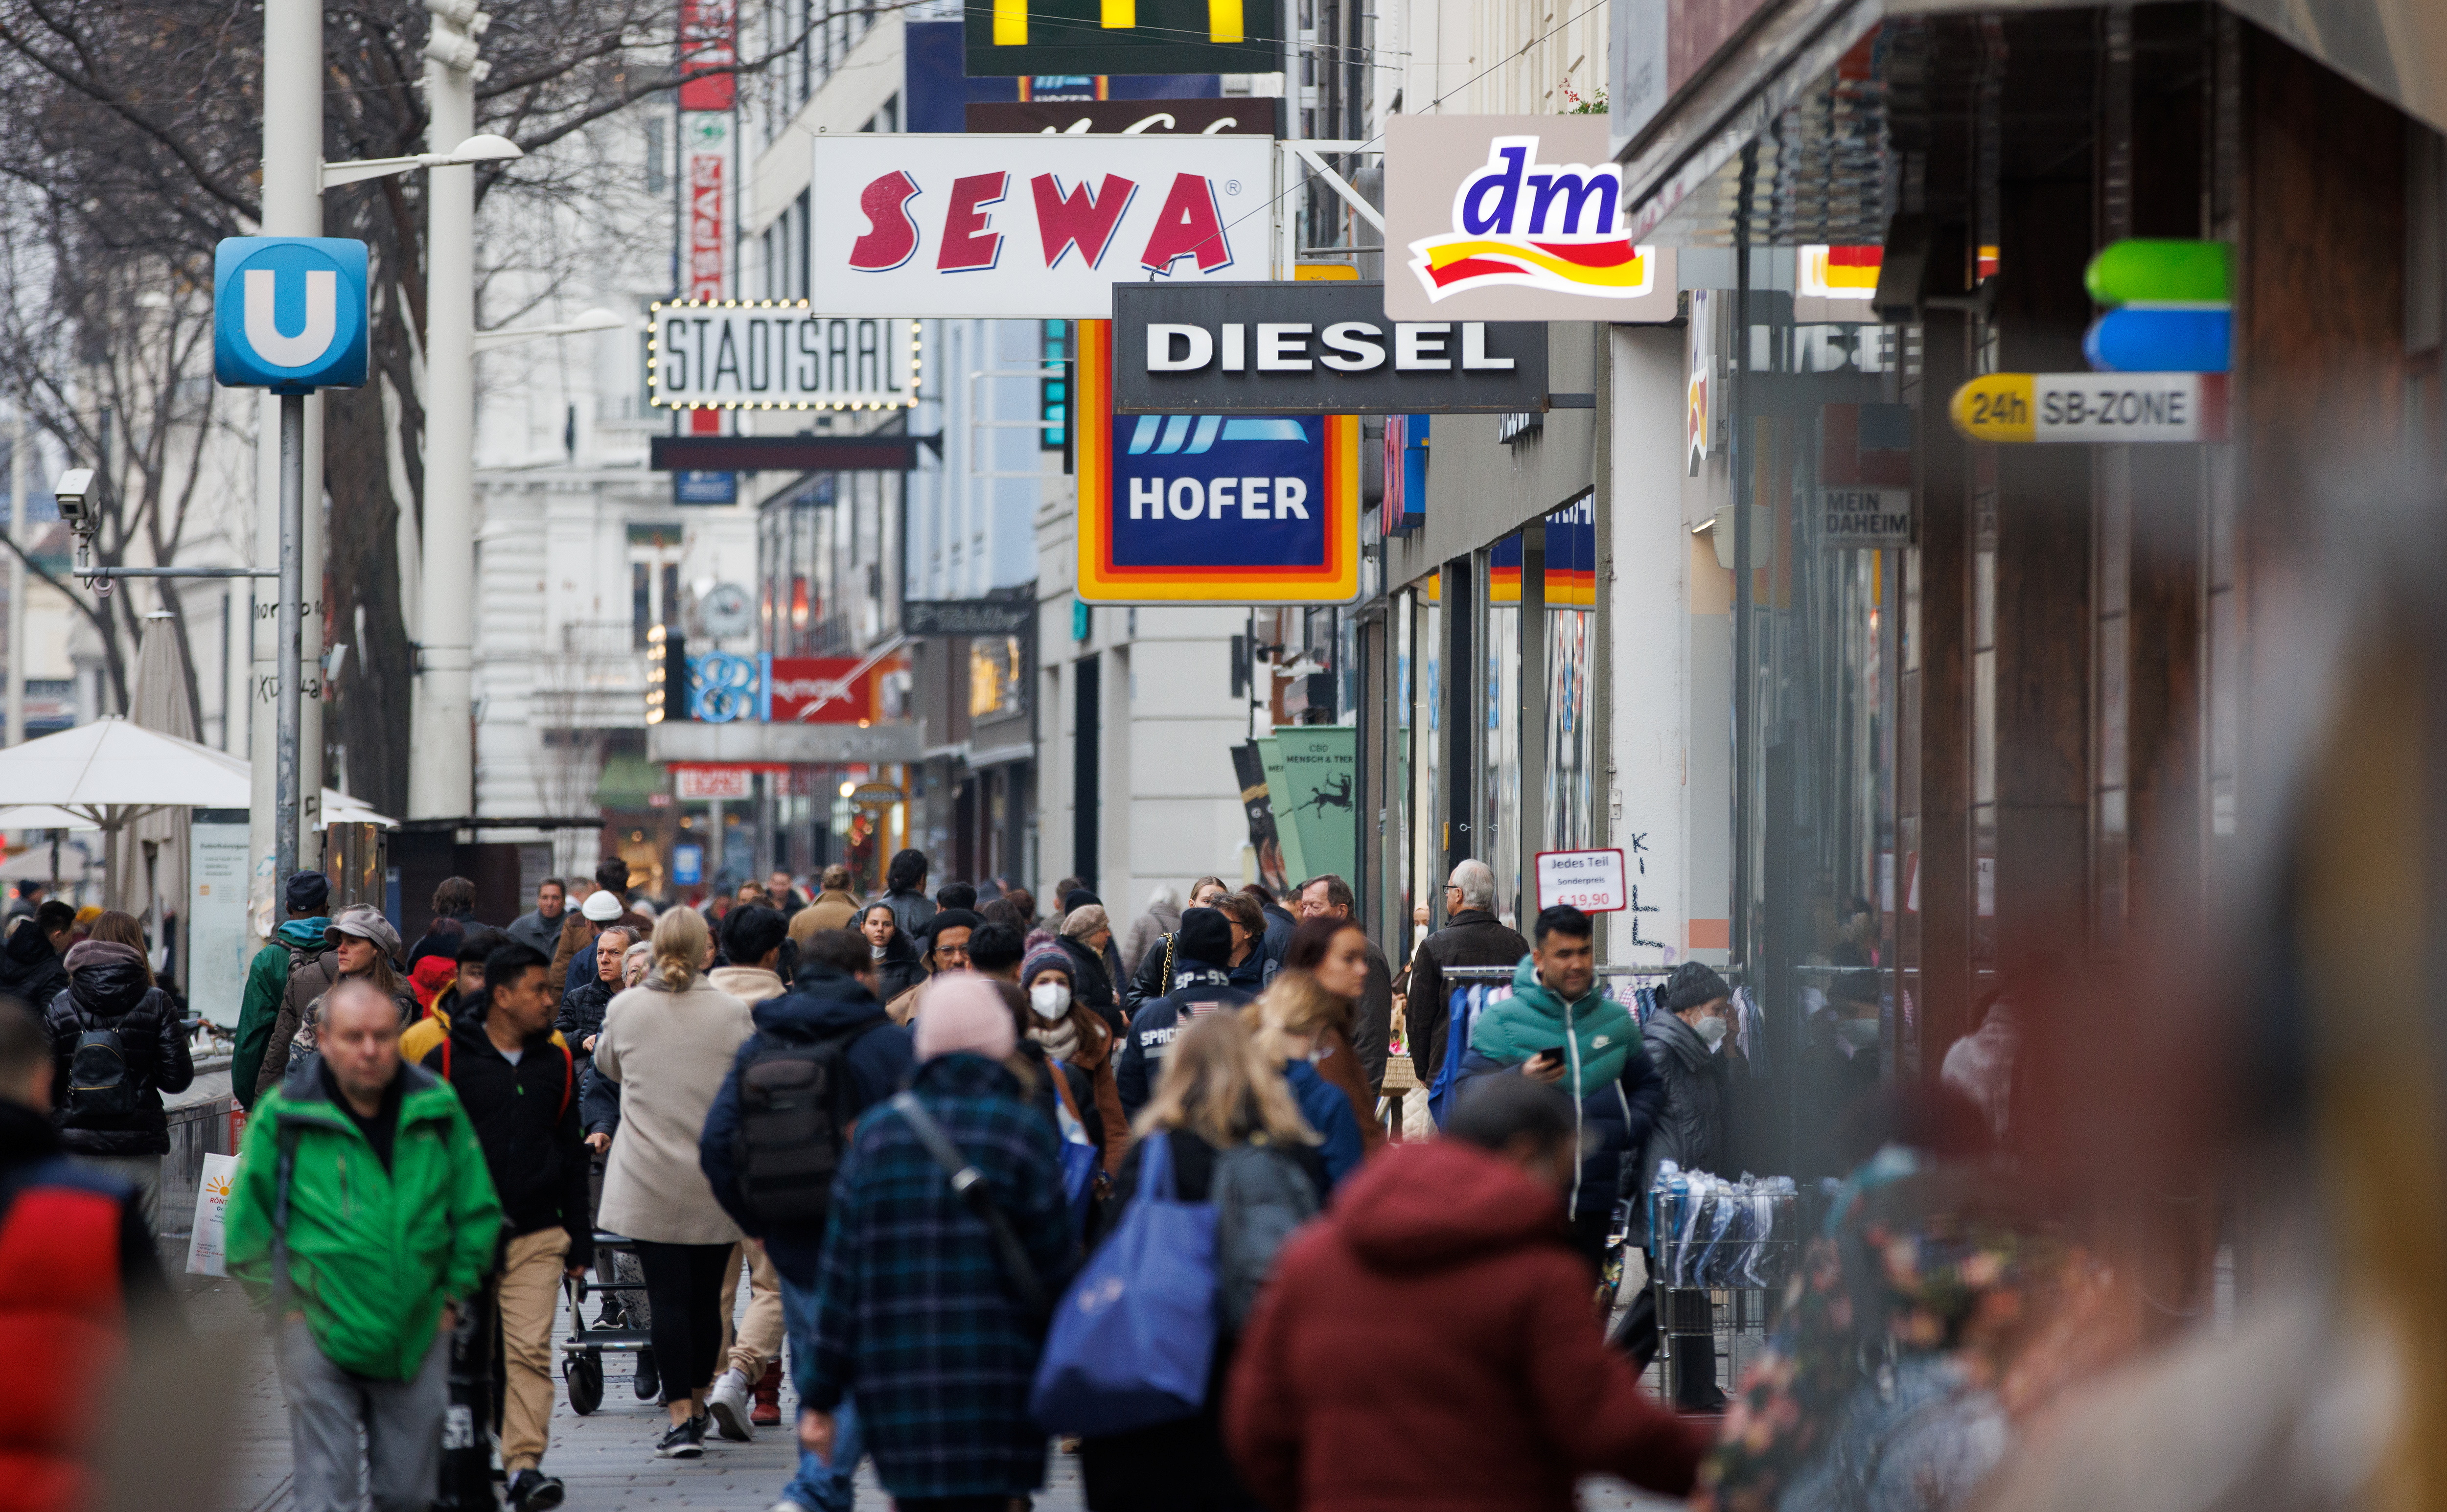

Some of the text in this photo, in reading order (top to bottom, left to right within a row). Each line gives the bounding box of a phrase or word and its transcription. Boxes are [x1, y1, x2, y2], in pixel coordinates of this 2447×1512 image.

[1462, 147, 1619, 235] dm
[848, 170, 1234, 276] SEWA
[244, 270, 337, 368] U
[667, 319, 901, 392] STADTSAAL
[1146, 321, 1515, 373] DIESEL
[1972, 390, 2187, 425] 24h SB-ZONE
[1129, 477, 1309, 520] HOFER
[1827, 493, 1880, 512] MEIN
[1826, 514, 1907, 534] DAHEIM
[1309, 744, 1328, 753] CBD
[1551, 856, 1609, 870] Jedes Teil
[1557, 876, 1605, 886] Sonderpreis
[1632, 833, 1665, 948] KILL
[1558, 893, 1610, 908] € 19,90
[209, 1197, 228, 1205] RÖNT
